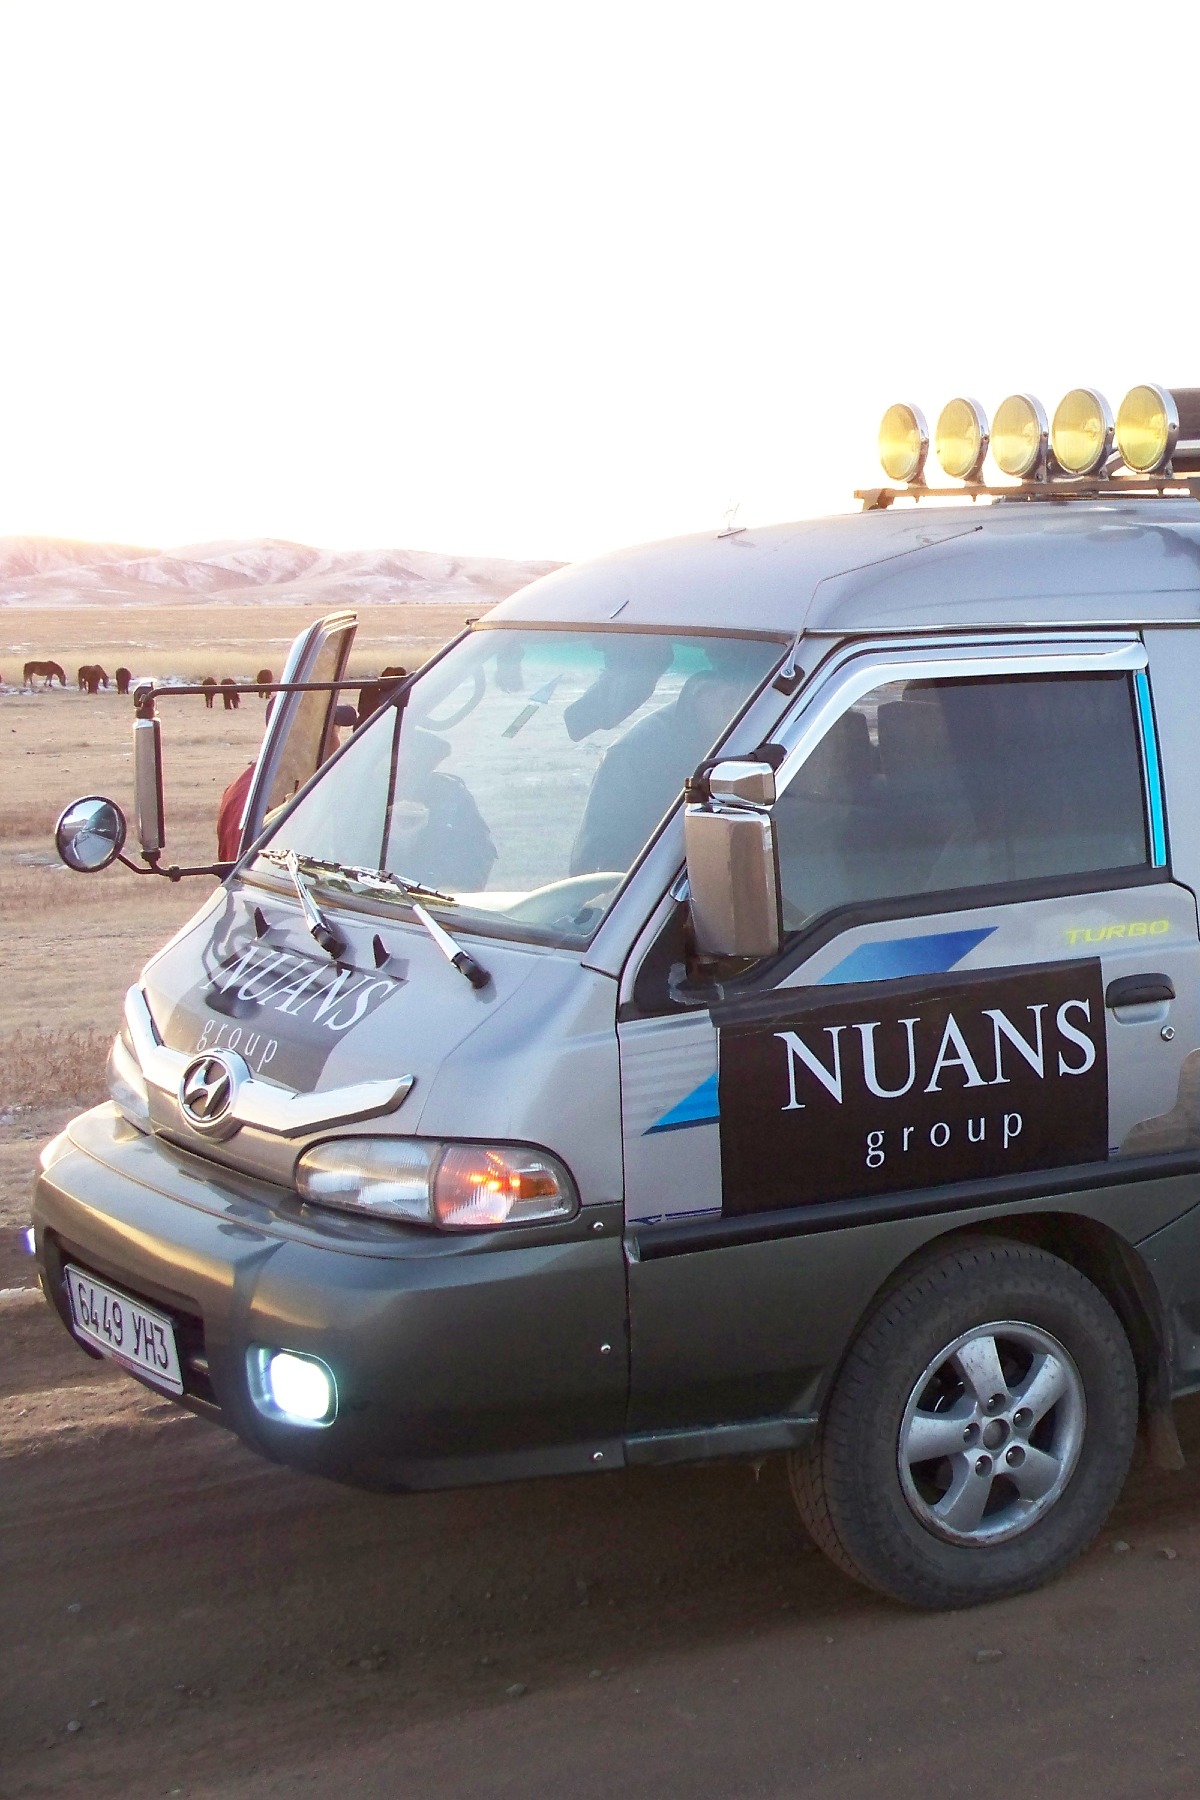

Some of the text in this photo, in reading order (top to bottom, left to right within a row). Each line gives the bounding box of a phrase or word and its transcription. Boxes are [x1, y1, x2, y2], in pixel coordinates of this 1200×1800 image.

[1065, 919, 1170, 945] TURBO
[200, 945, 399, 1031] NUANS
[196, 1018, 279, 1074] group
[773, 998, 1098, 1112] NUANS
[865, 1111, 1024, 1168] group
[78, 1281, 124, 1347] 6449
